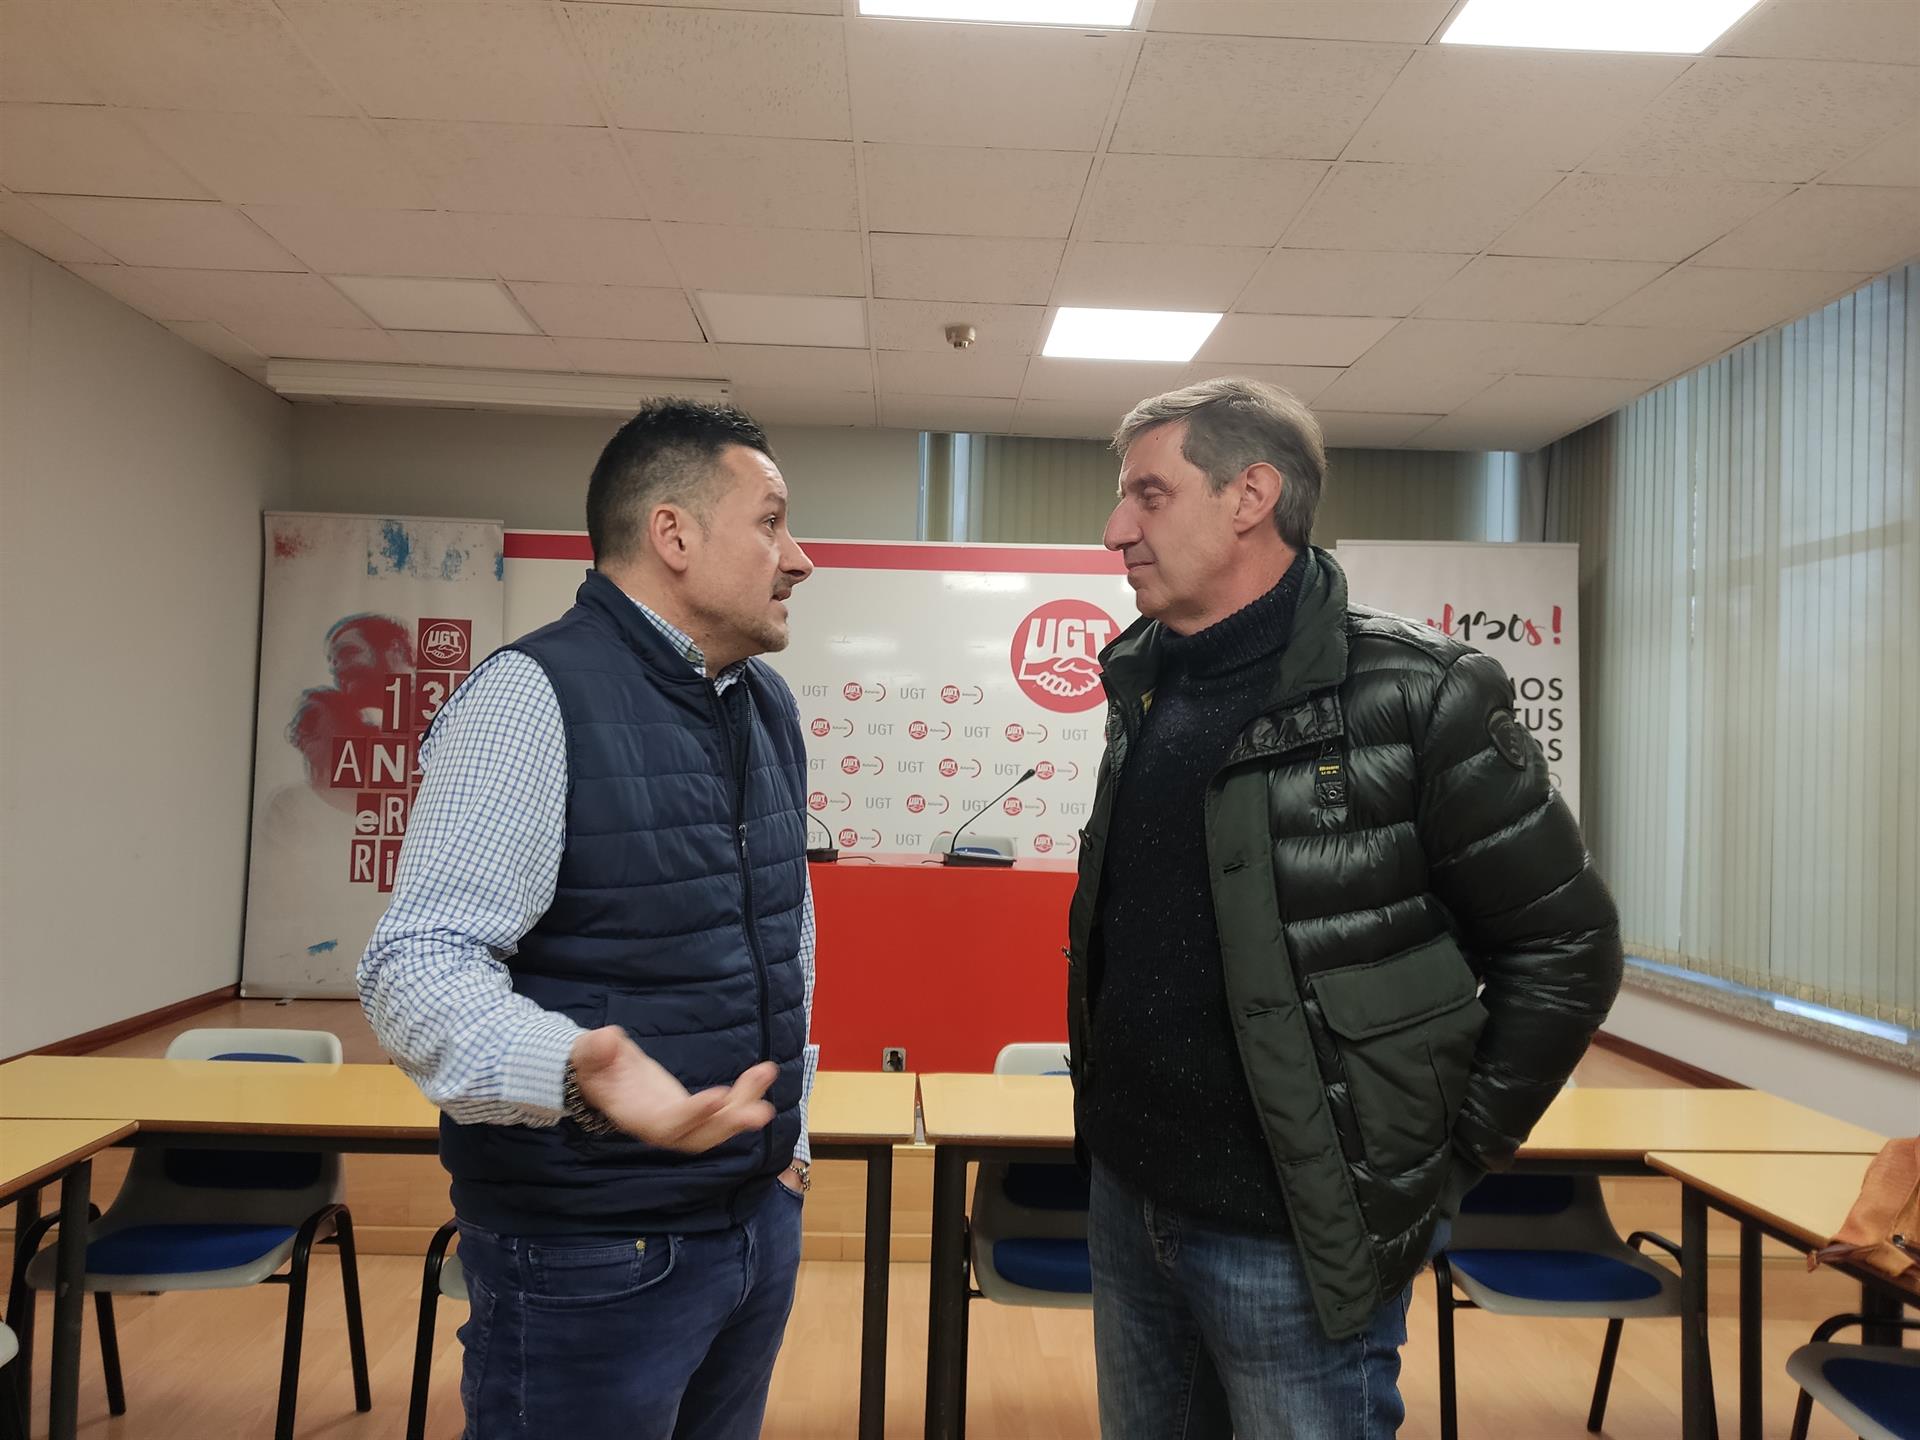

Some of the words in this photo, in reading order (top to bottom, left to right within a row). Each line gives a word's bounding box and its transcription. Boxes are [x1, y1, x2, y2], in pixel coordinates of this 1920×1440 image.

[427, 630, 461, 648] UGT
[1023, 618, 1112, 659] UGT
[802, 685, 829, 698] UGT
[900, 687, 927, 700] UGT
[1509, 677, 1564, 701] OS
[867, 723, 894, 736] UGT
[964, 726, 992, 738] UGT
[1062, 729, 1089, 741] UGT
[809, 758, 826, 771] GT
[897, 761, 925, 774] UGT
[994, 764, 1021, 776] UGT
[865, 797, 892, 810] UGT
[962, 799, 989, 812] UGT
[1060, 802, 1088, 815] UGT
[808, 831, 824, 844] GT
[895, 834, 922, 847] UGT
